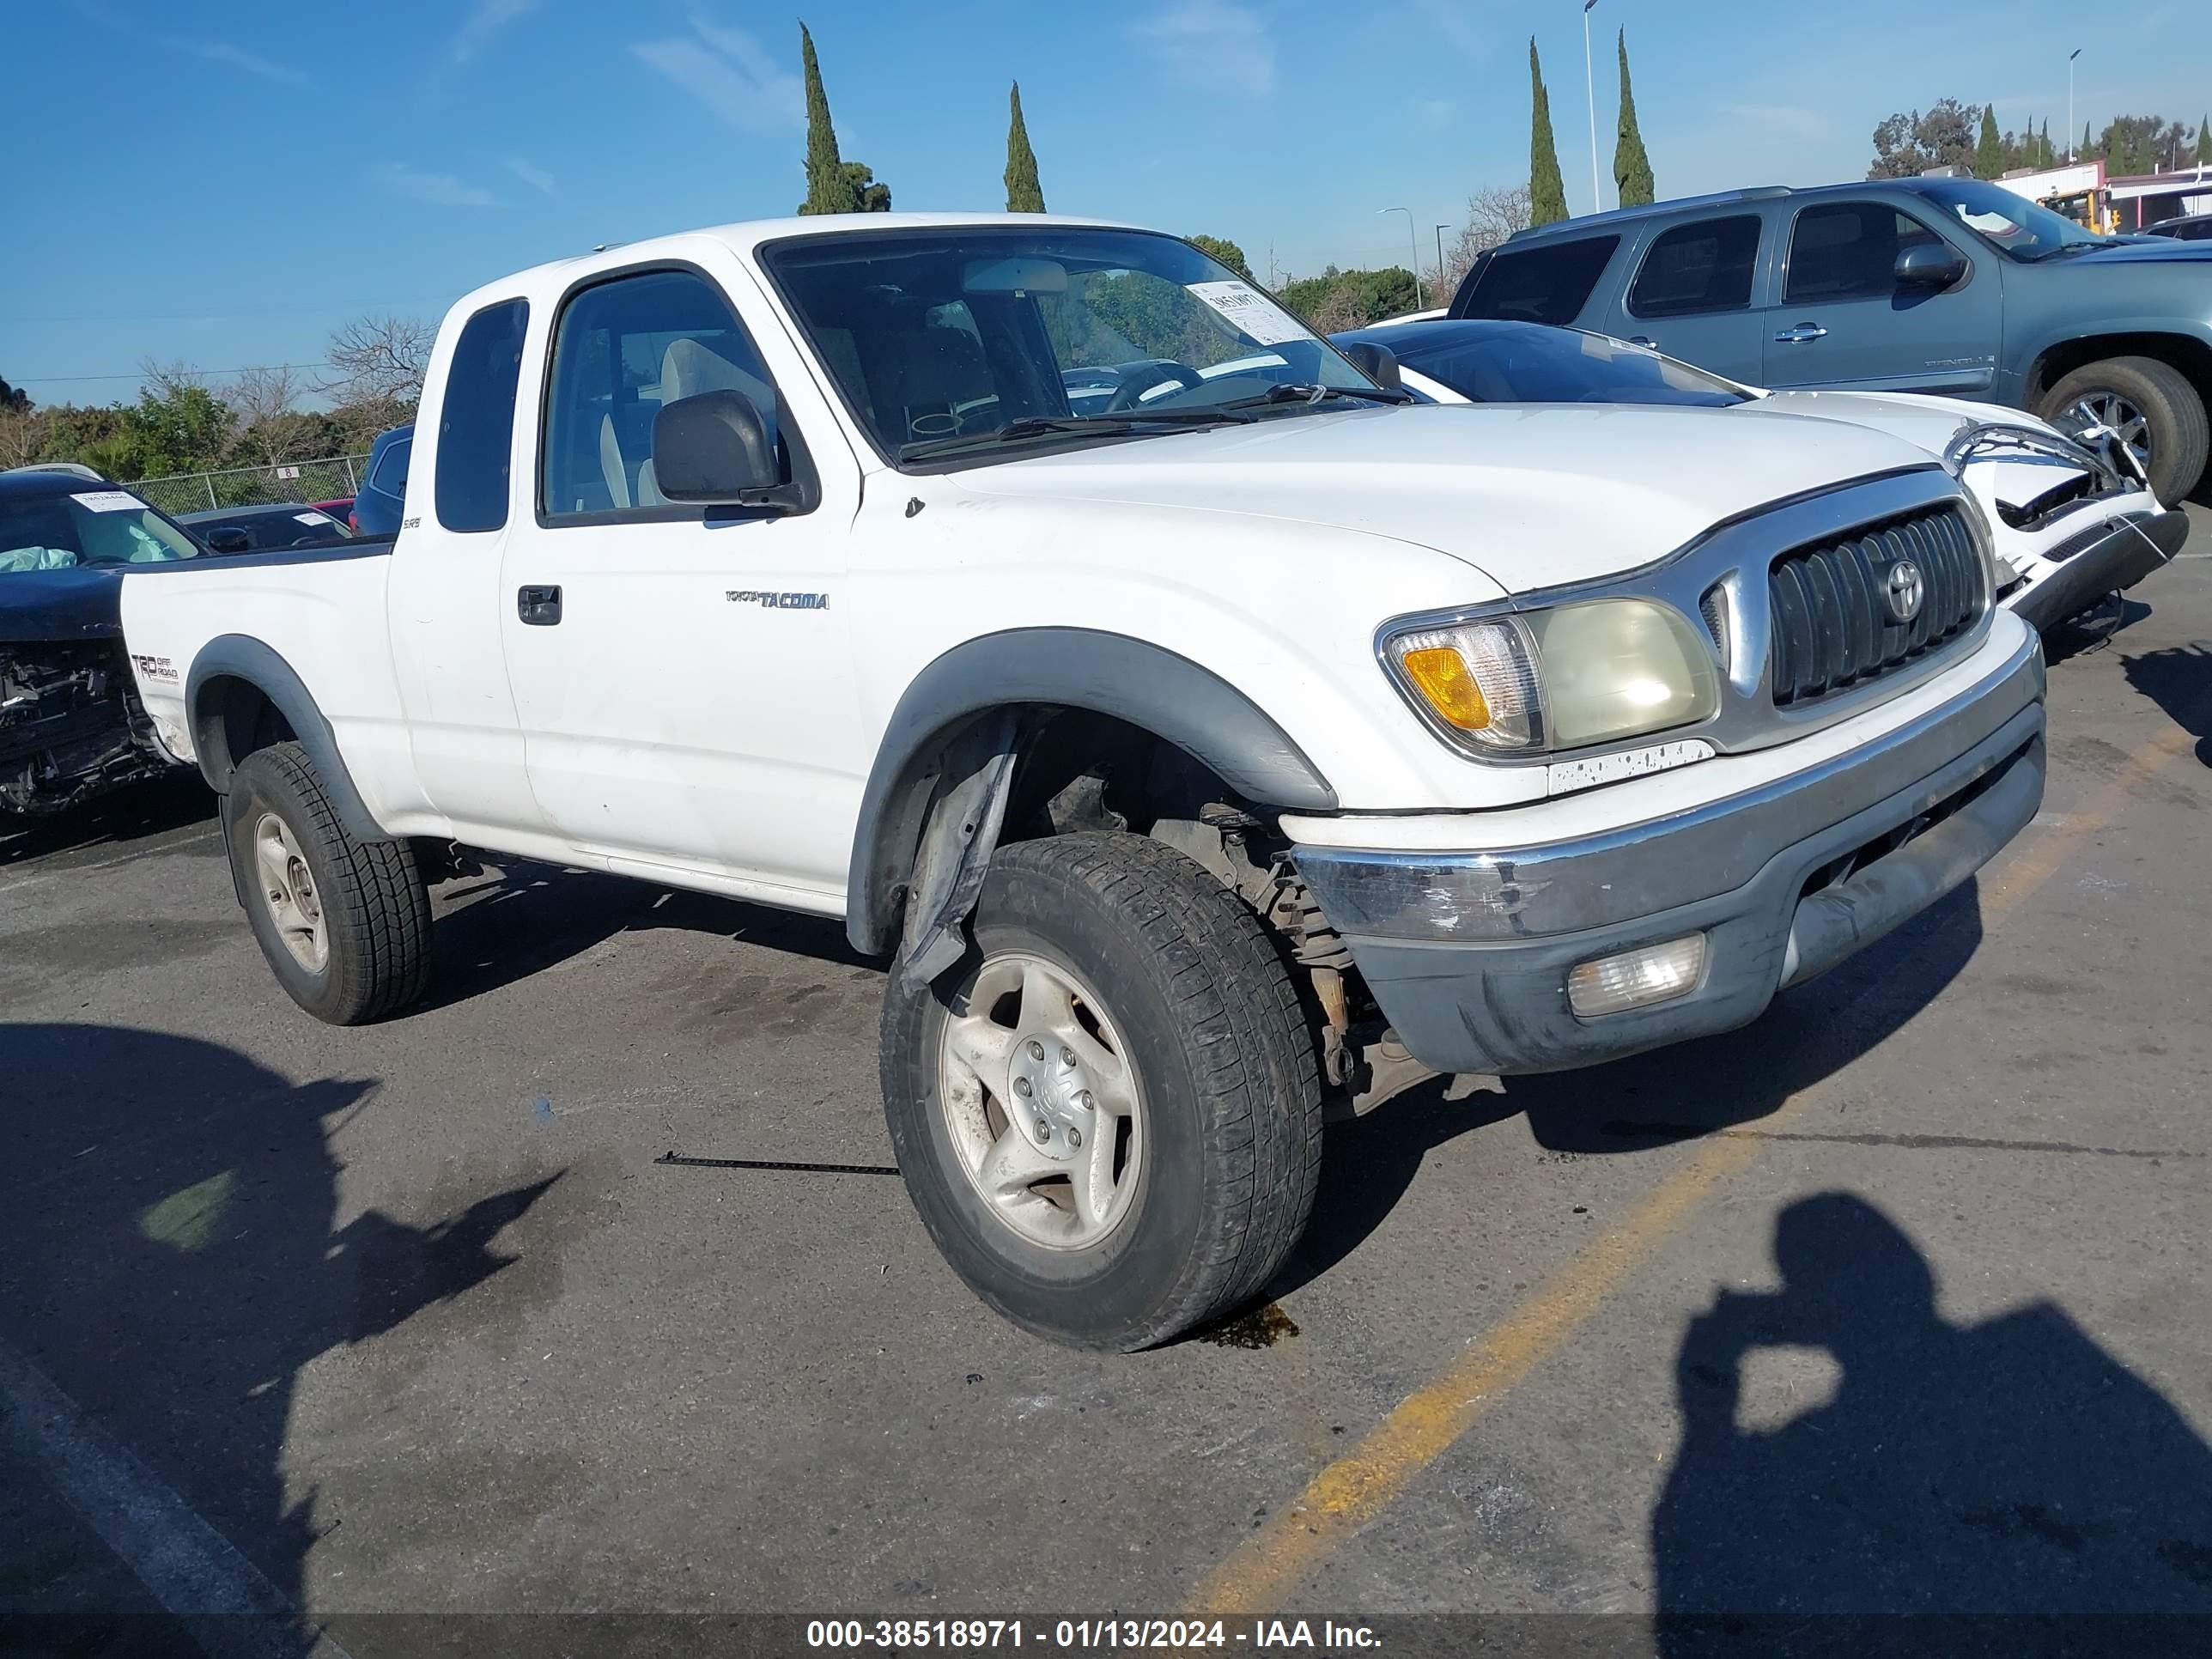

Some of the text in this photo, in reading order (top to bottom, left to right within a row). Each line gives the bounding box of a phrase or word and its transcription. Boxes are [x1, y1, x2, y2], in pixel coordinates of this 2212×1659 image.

[1209, 293, 1265, 309] 38518971
[285, 468, 292, 477] 8
[726, 590, 830, 611] TOYOTA TACOMA
[131, 653, 157, 681] TRD
[158, 668, 179, 678] ROAD
